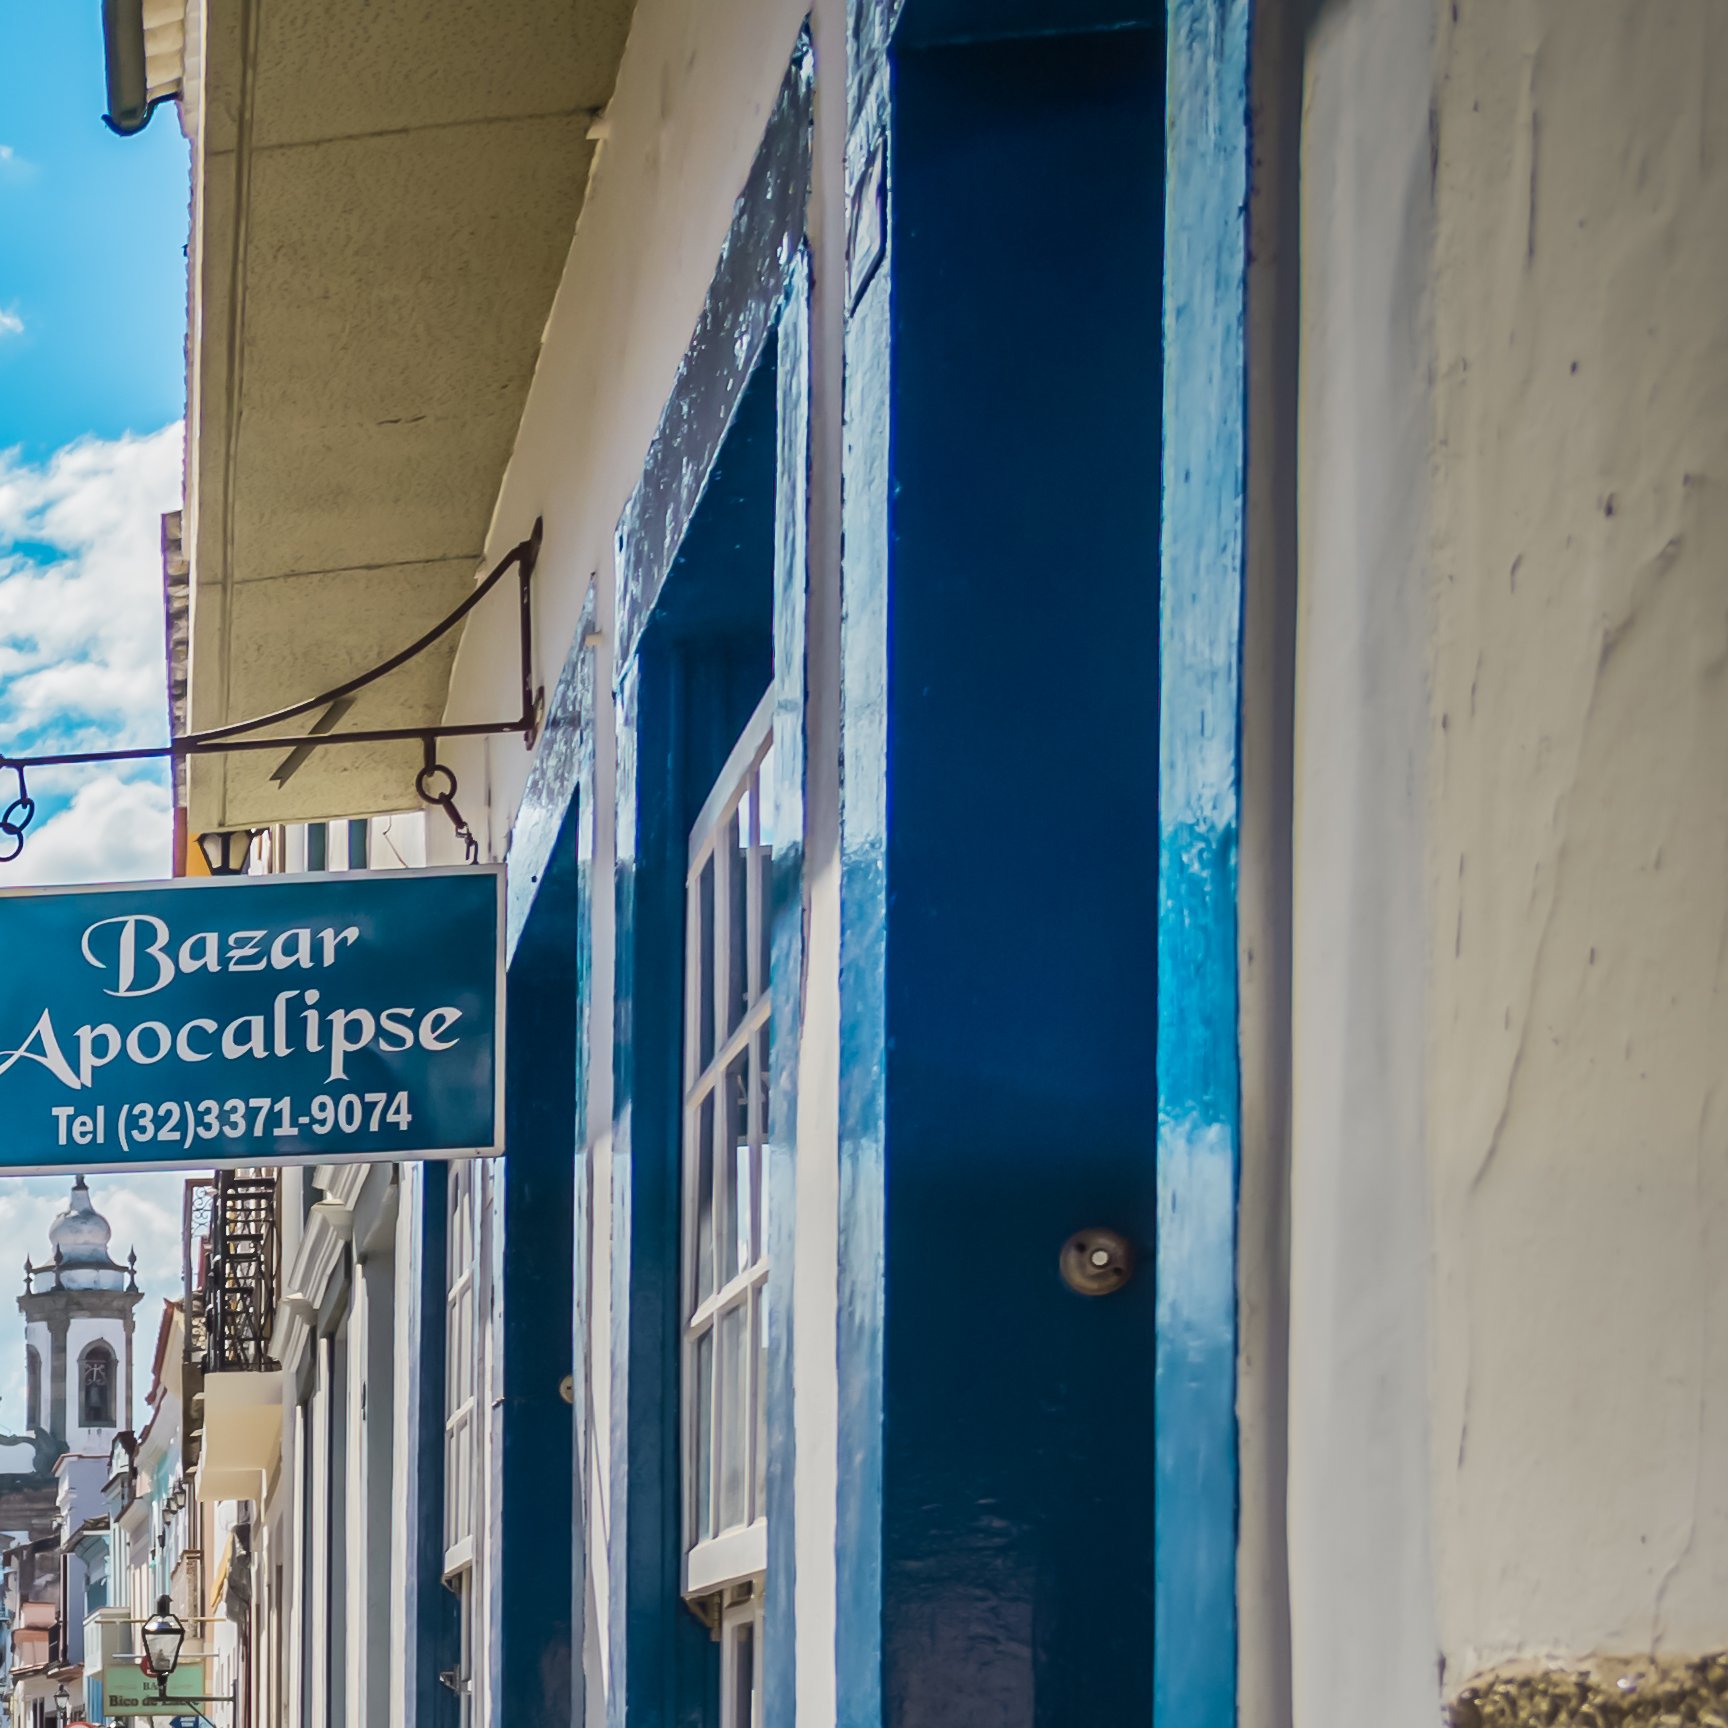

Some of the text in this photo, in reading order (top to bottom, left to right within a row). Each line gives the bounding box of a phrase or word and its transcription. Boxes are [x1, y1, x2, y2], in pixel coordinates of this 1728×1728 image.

[81, 914, 360, 998] Bazar
[51, 1090, 412, 1152] Tel (32)3371-9074
[108, 1694, 140, 1707] Bico
